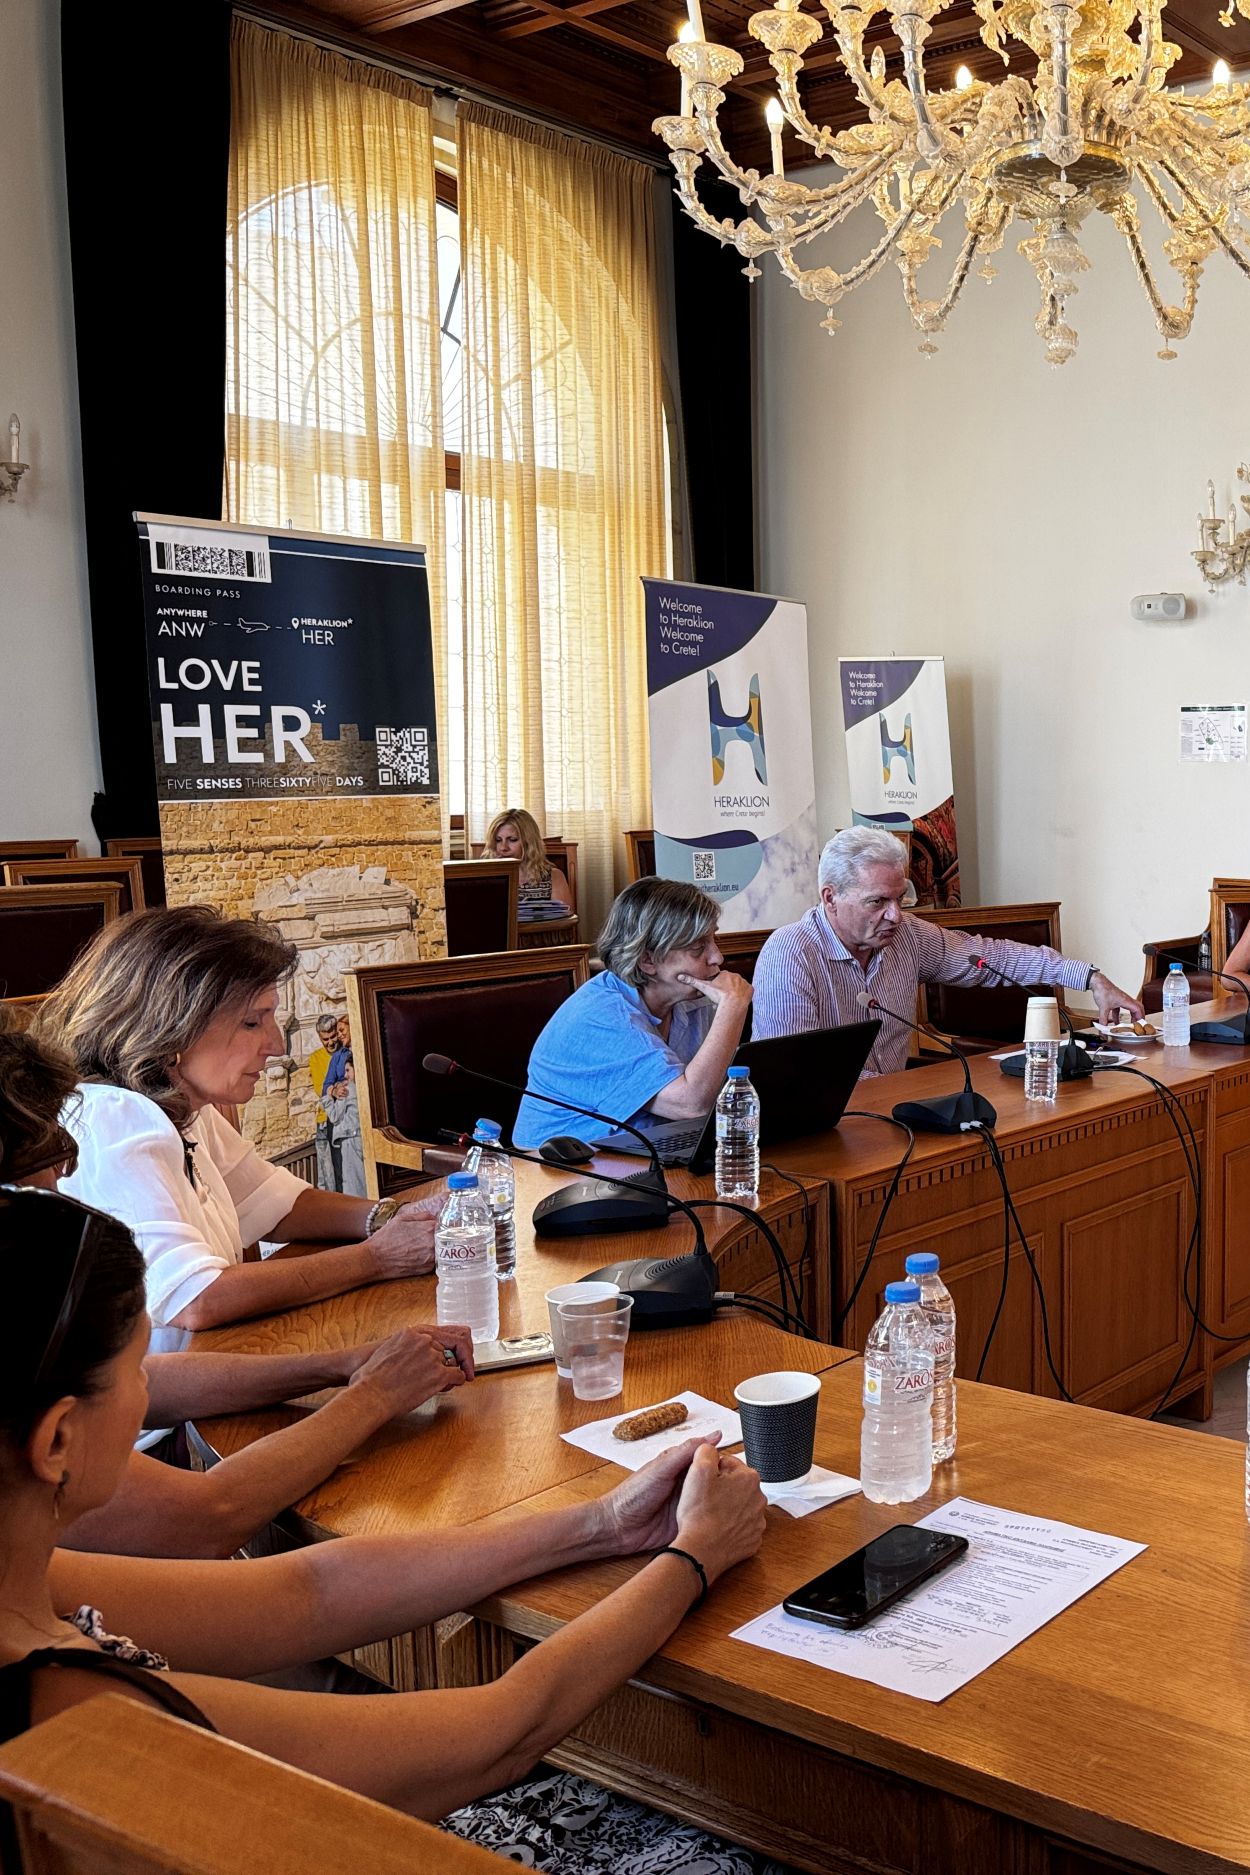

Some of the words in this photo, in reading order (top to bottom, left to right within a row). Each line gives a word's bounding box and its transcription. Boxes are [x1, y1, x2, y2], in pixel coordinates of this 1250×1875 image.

[155, 584, 211, 597] BOARDING
[216, 589, 241, 599] PASS
[659, 596, 702, 613] Welcome
[156, 607, 208, 618] ANYWHERE
[660, 613, 669, 624] to
[671, 613, 714, 629] Heraklion
[157, 620, 205, 637] ANW
[660, 626, 704, 643] Welcome
[302, 629, 335, 645] HER
[660, 642, 669, 653] to
[157, 656, 263, 692] LOVE
[849, 671, 876, 679] Welcome
[856, 680, 883, 688] Heraklion
[850, 689, 877, 697] Welcome
[167, 779, 193, 790] FIVE
[196, 778, 242, 789] SENSES
[336, 776, 364, 787] DAYS
[714, 796, 770, 807] HERAKLION
[884, 791, 918, 799] HERAKLION
